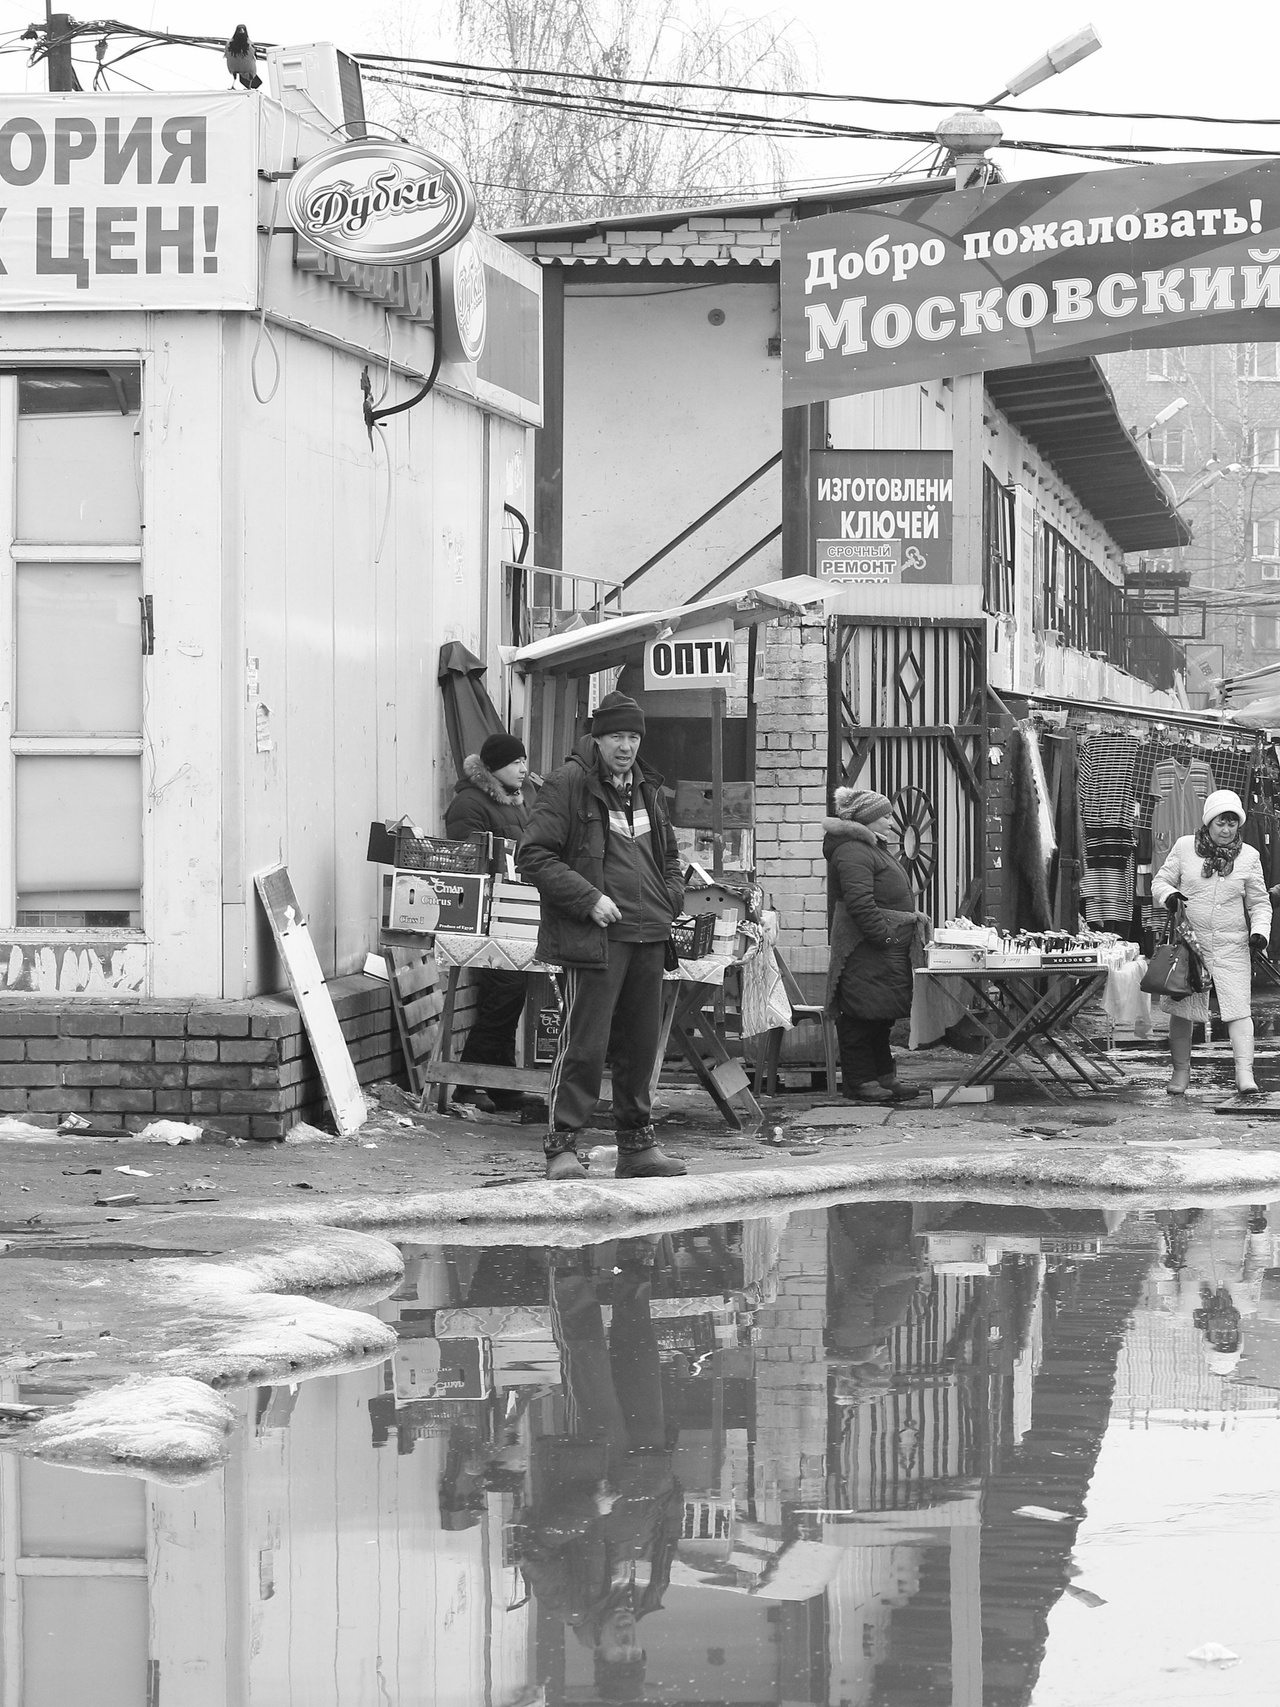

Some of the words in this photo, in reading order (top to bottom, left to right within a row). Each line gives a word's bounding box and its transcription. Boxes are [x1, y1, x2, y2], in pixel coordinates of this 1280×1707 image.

[0, 116, 207, 187] ОРИЯ
[310, 166, 446, 231] Дубки
[36, 206, 219, 290] ЦЕН!
[804, 234, 946, 294] Добро
[963, 199, 1263, 261] пожаловать!
[817, 477, 952, 503] ИЗГОТОВЛЕНИ
[840, 505, 939, 539] КЛЮЧЕЙ
[821, 560, 897, 574] РЕМОНТ
[827, 544, 891, 557] СРОЧНЫЙ
[653, 642, 733, 676] ОПТИ
[421, 895, 452, 907] Citrus
[399, 915, 419, 924] Class
